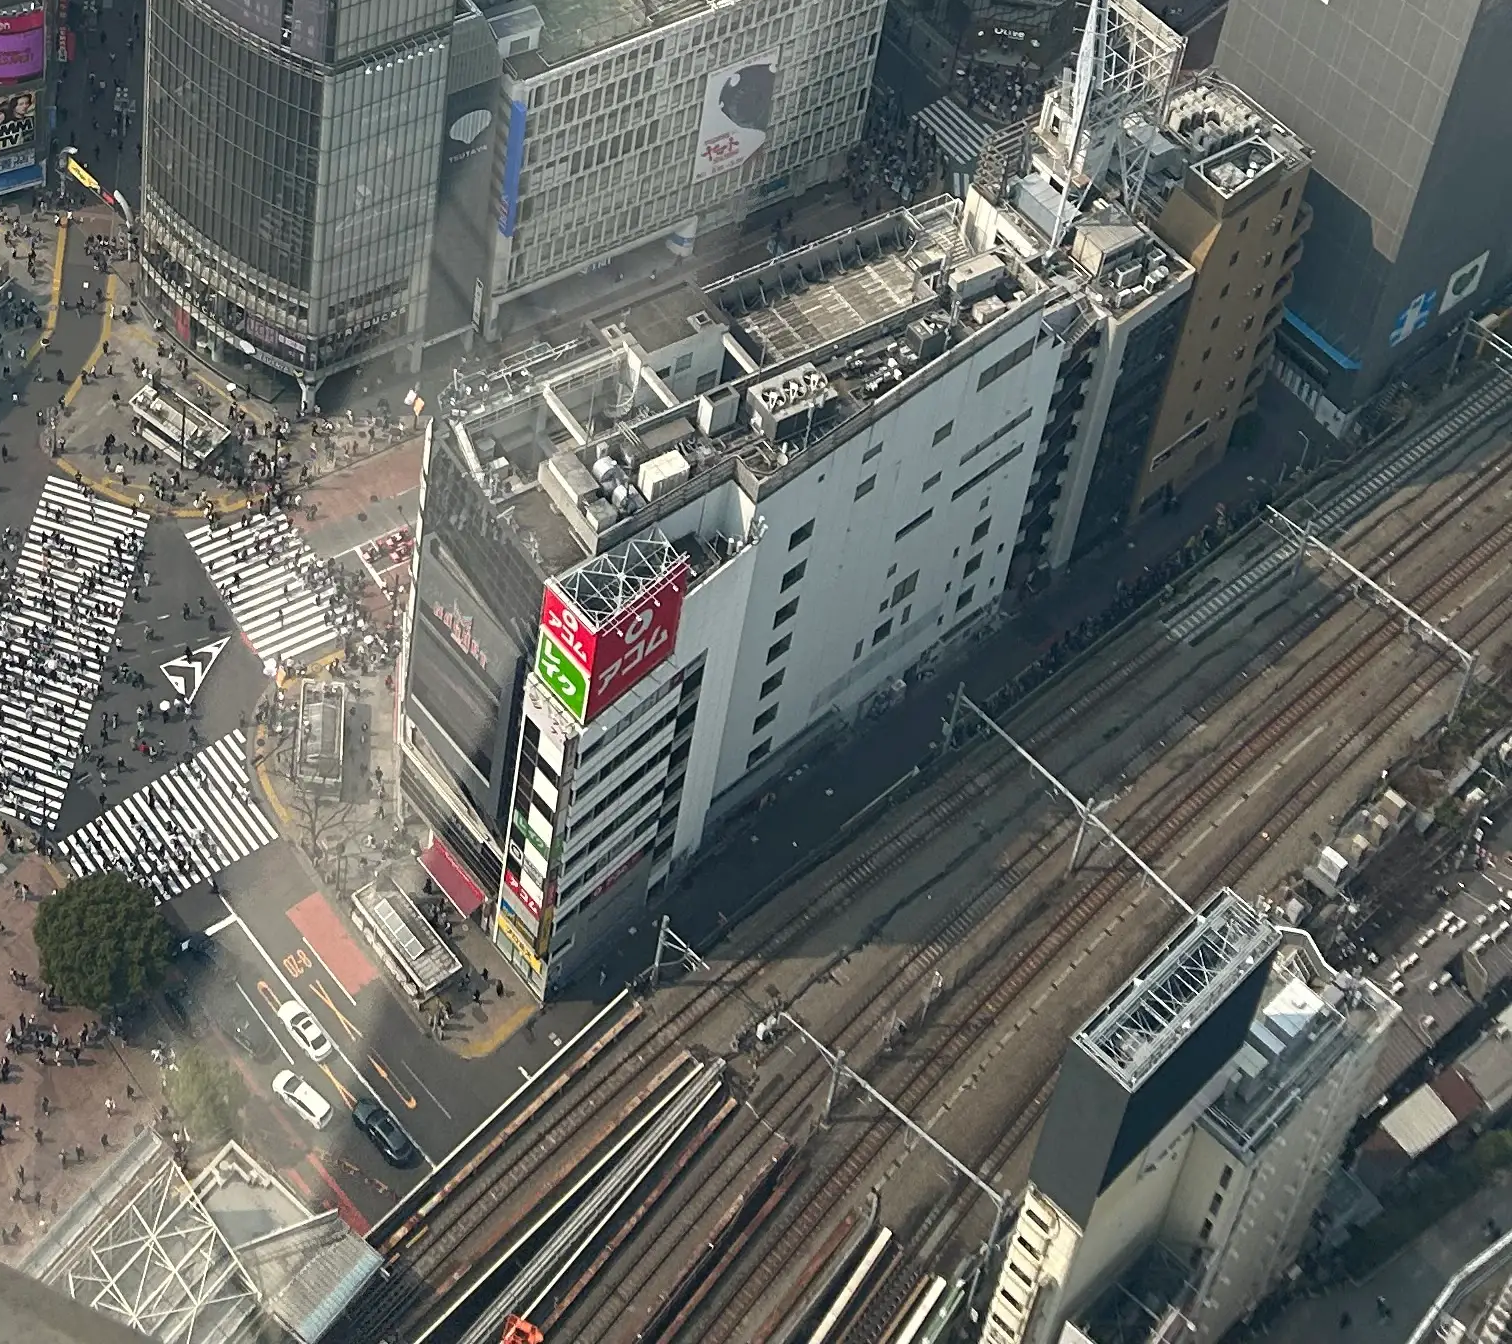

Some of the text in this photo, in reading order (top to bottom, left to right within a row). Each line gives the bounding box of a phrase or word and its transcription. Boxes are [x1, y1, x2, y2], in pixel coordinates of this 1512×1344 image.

[0, 133, 20, 150] TV
[448, 144, 488, 164] TSUTAYA
[547, 609, 588, 664] アコム
[541, 639, 578, 697] レイク
[596, 623, 671, 697] アコム
[506, 876, 541, 913] アコム
[282, 948, 313, 979] 8-20
